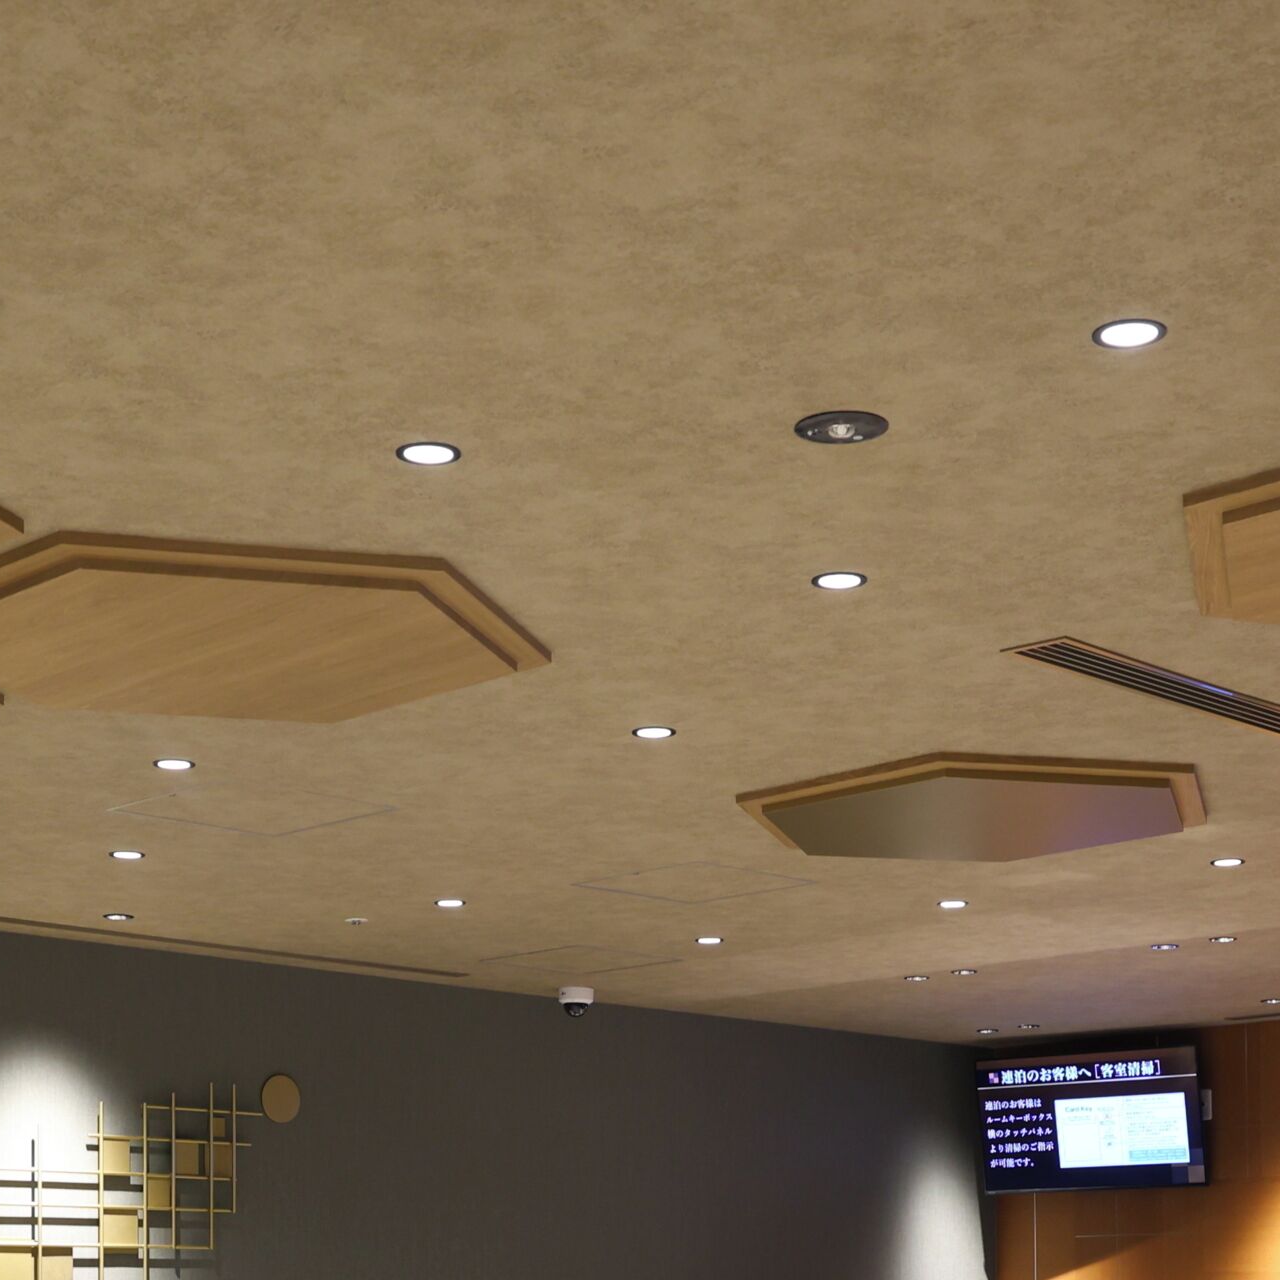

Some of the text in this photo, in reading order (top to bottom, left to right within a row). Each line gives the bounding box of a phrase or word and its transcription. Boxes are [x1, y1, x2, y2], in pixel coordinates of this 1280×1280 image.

[985, 1099, 1042, 1111] 連泊のお客様は
[986, 1113, 1053, 1124] ルームキーボックス
